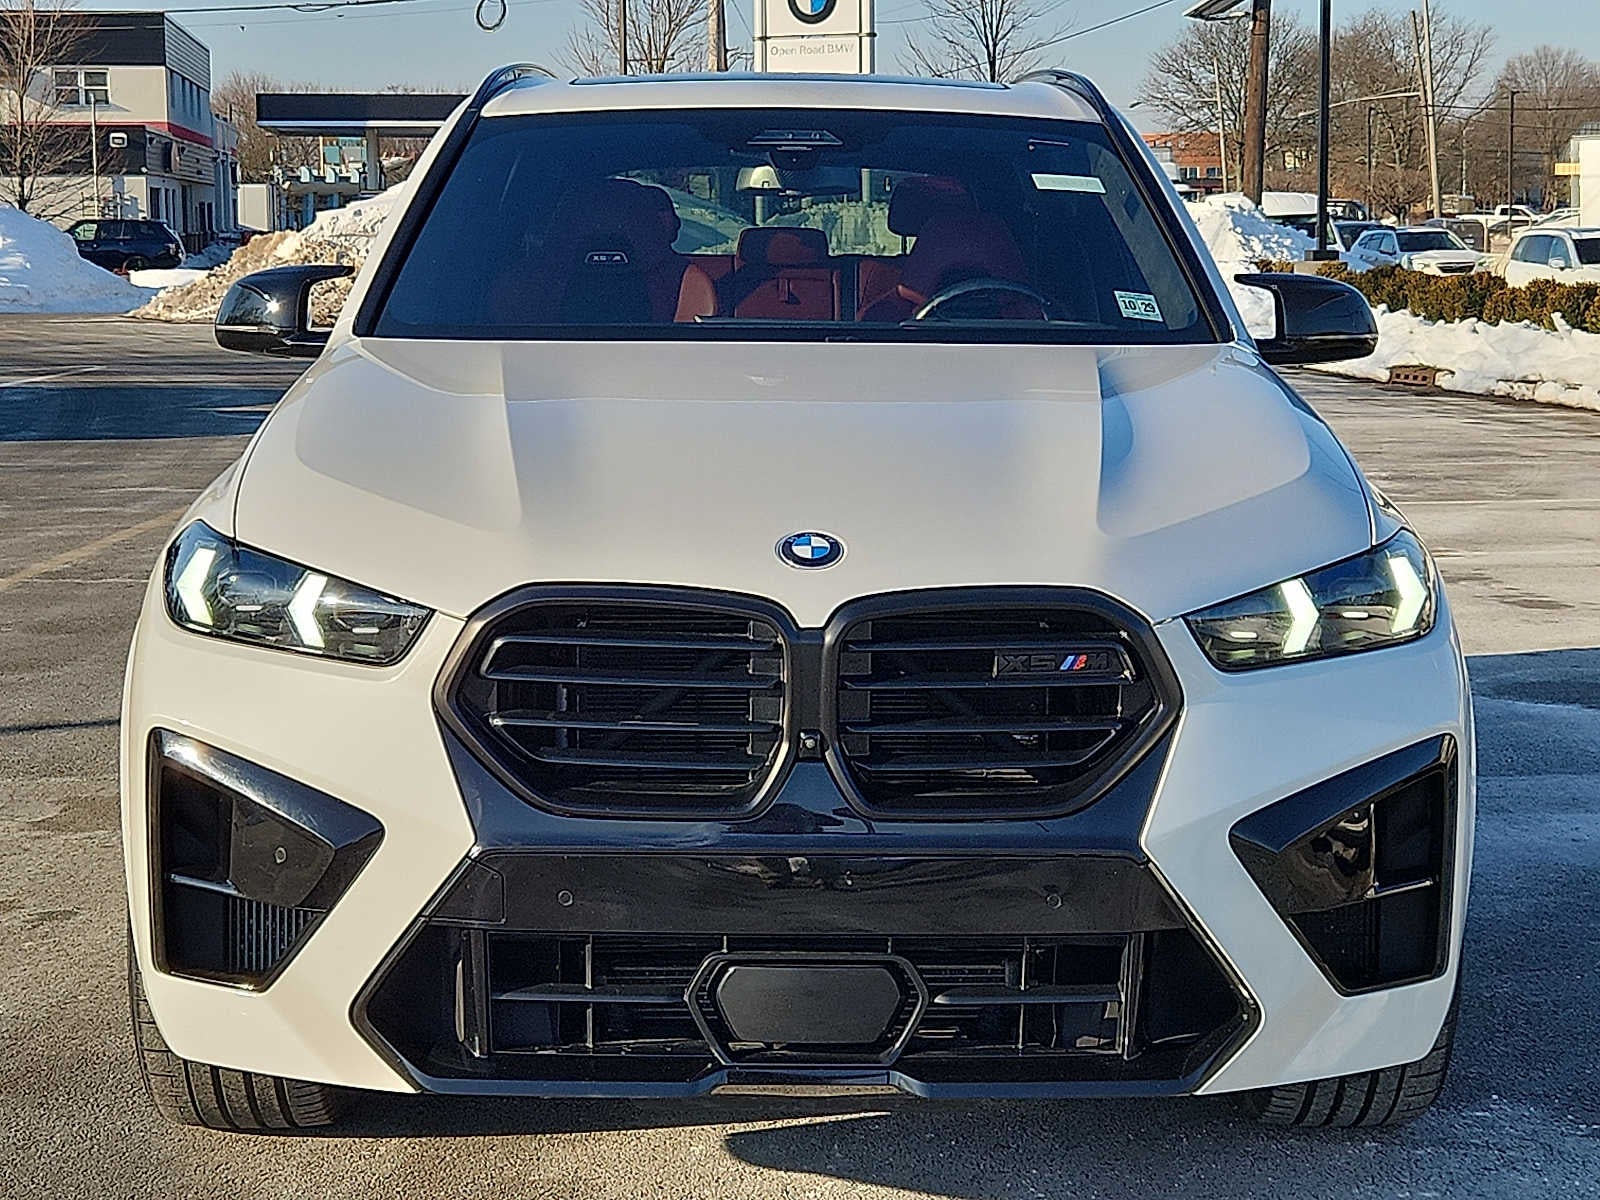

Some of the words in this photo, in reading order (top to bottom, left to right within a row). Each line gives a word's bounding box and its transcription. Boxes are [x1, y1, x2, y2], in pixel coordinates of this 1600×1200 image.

[770, 45, 797, 57] Open
[799, 44, 825, 55] Road
[827, 43, 855, 53] BMW
[1121, 299, 1137, 311] 10
[1140, 301, 1156, 314] 29
[1001, 655, 1056, 671] X5
